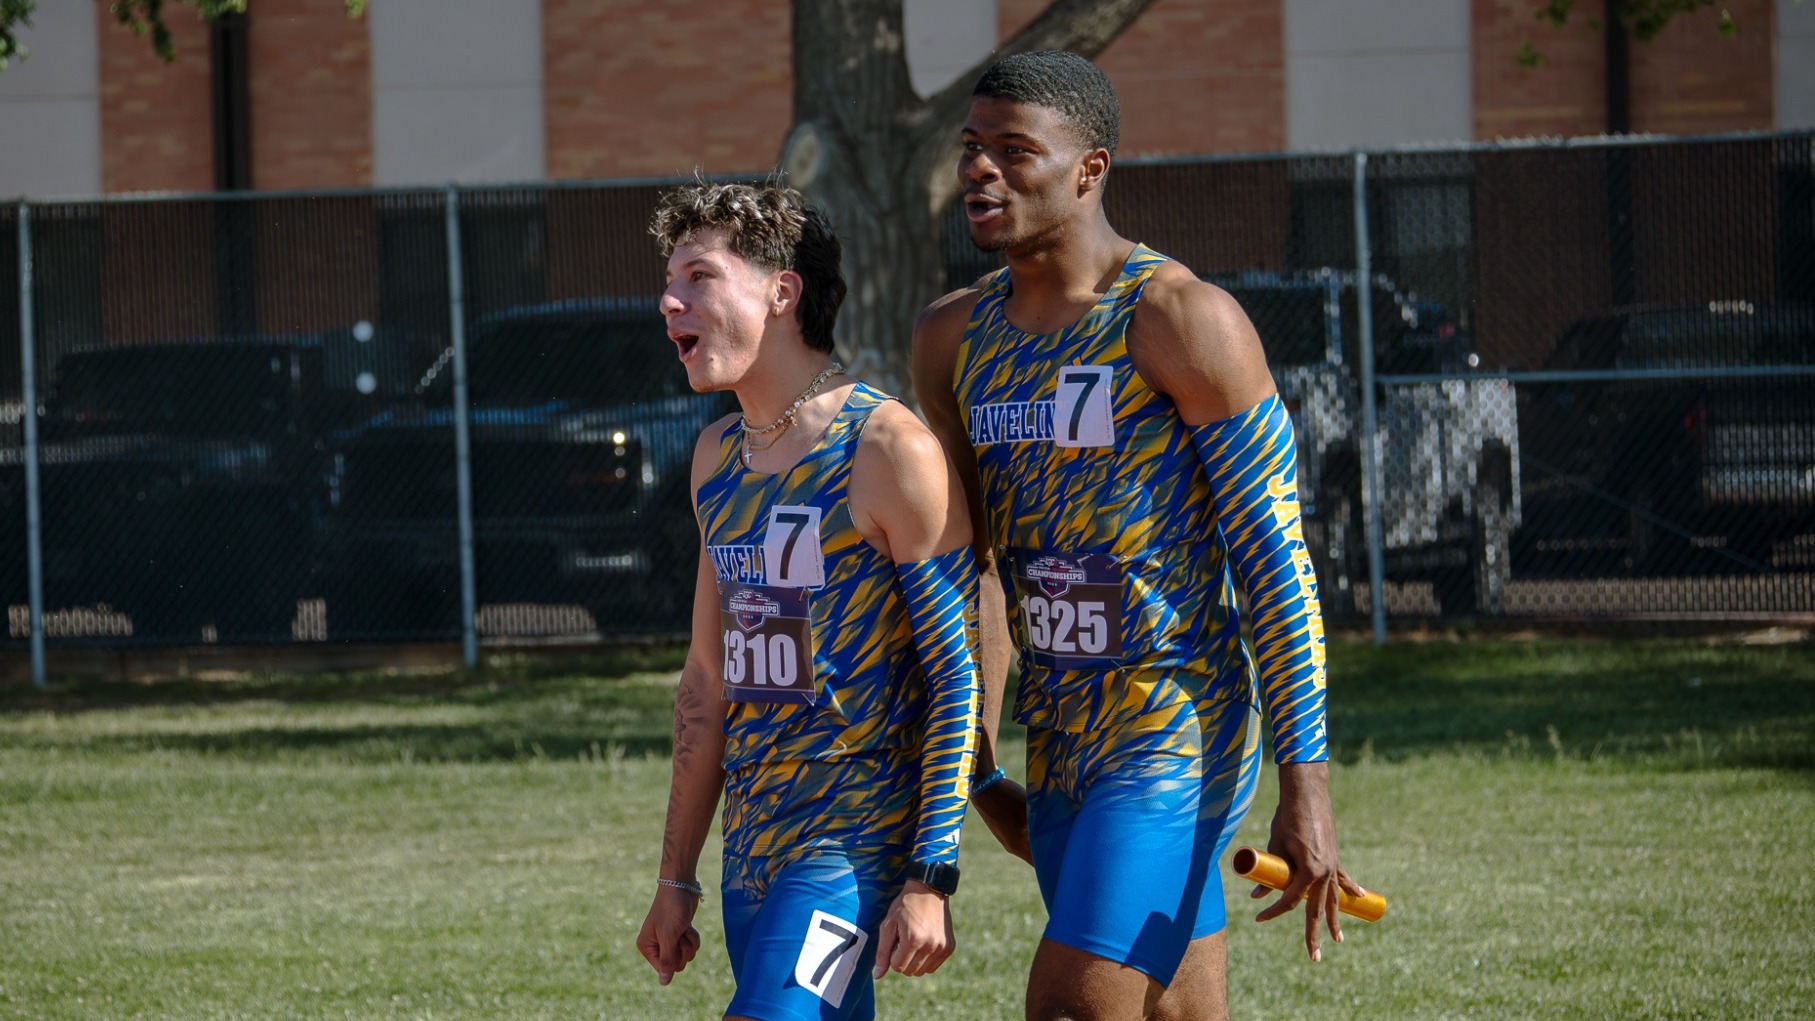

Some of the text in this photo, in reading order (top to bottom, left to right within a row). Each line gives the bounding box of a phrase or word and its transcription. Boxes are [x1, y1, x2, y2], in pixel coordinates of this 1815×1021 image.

[1064, 373, 1101, 441] 7
[775, 512, 810, 580] 7
[1028, 569, 1083, 580] CHAMPIONSHIPS
[730, 602, 777, 613] CHAMPIONSHIPS
[1020, 595, 1107, 653] 1325
[809, 918, 859, 988] 7
